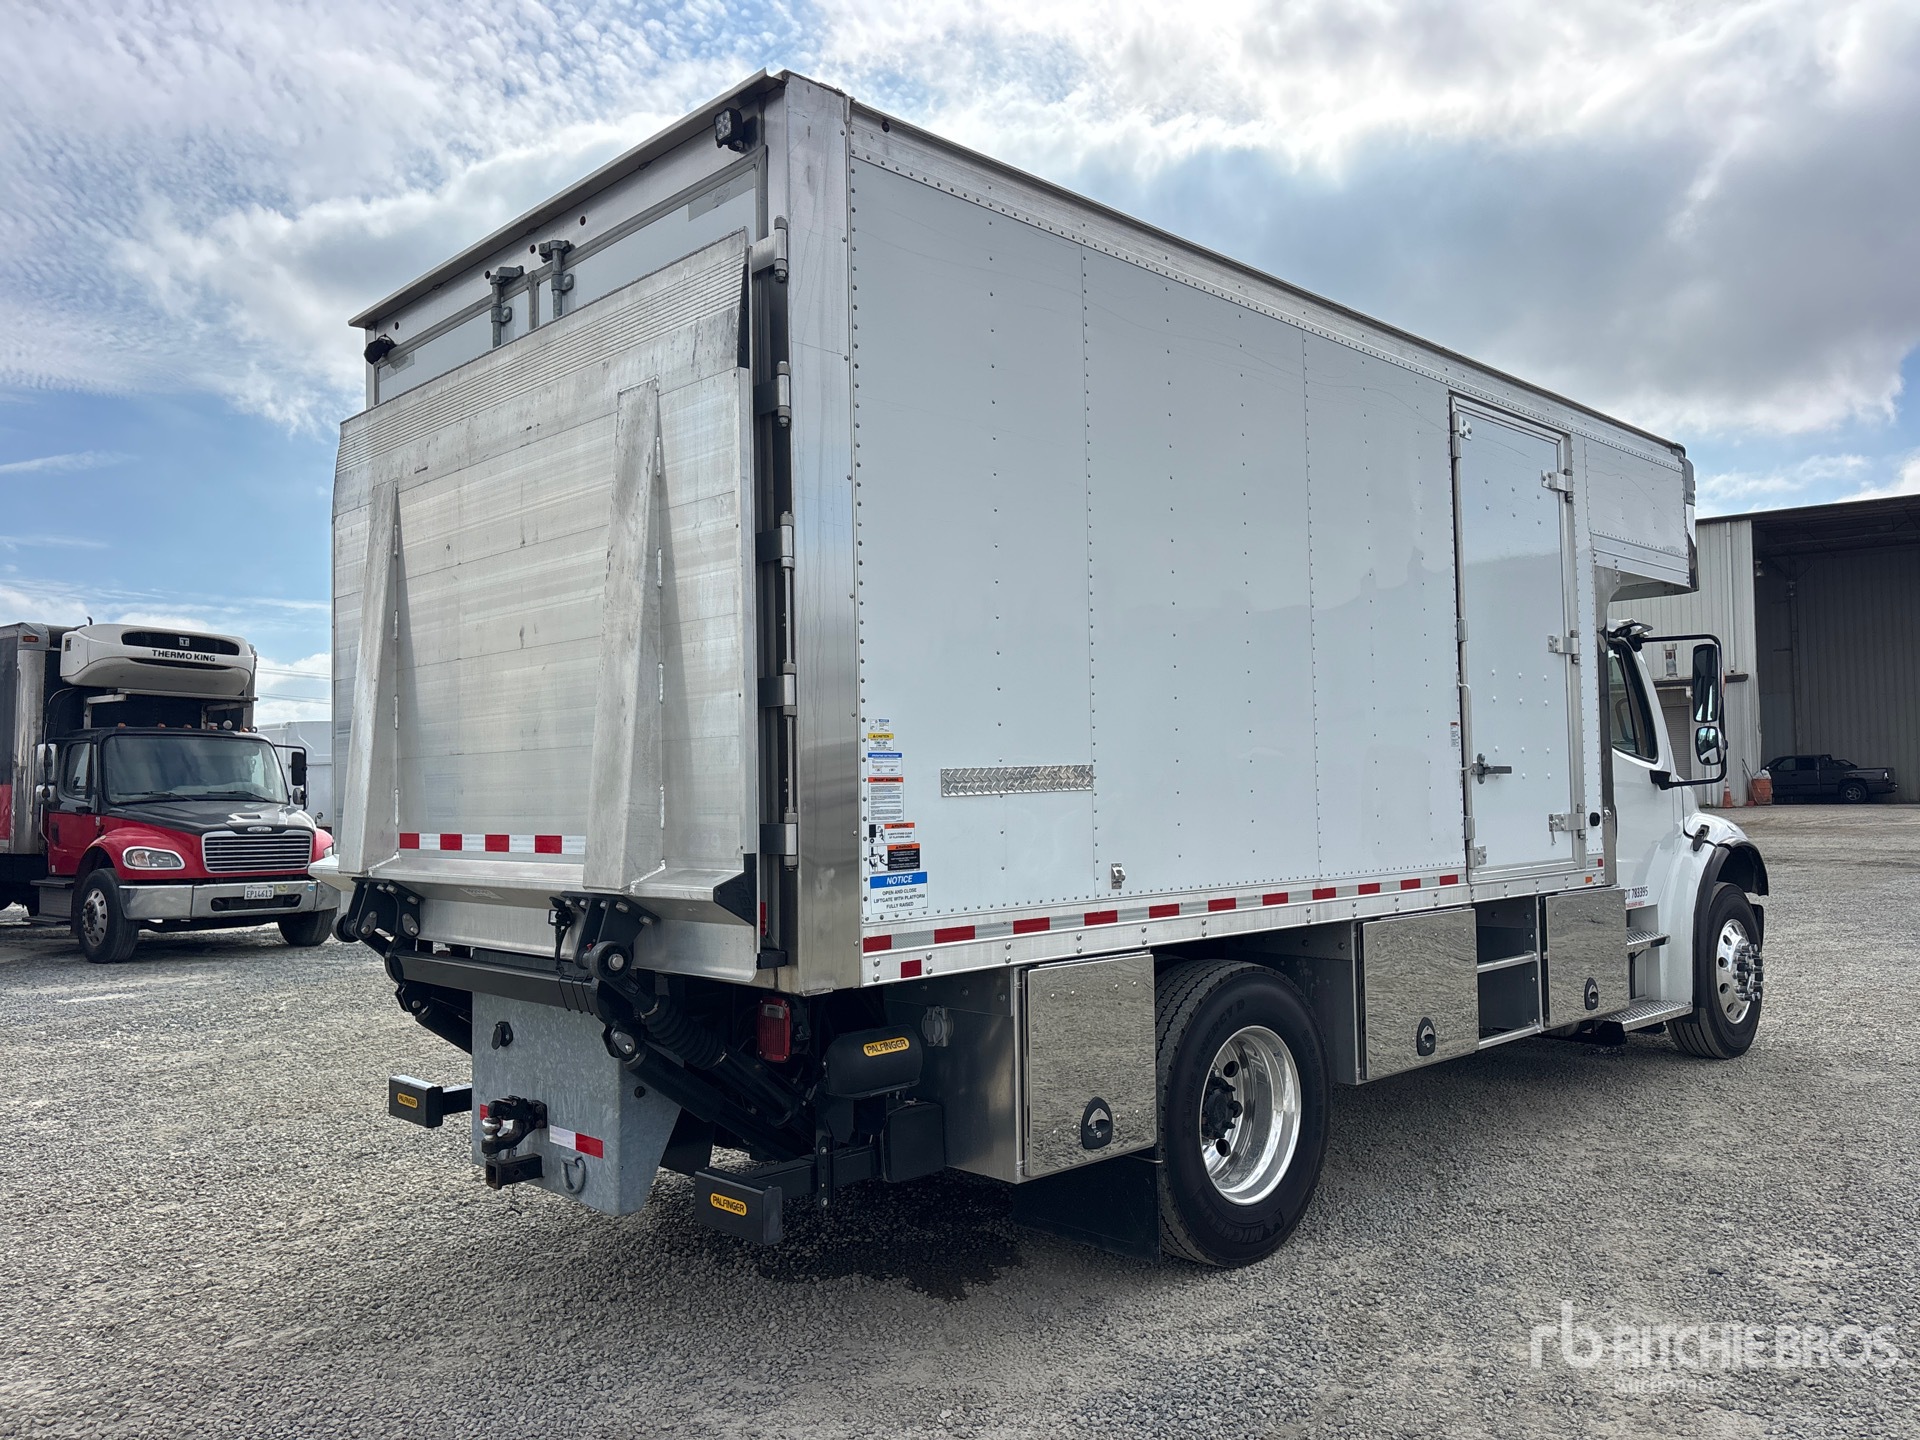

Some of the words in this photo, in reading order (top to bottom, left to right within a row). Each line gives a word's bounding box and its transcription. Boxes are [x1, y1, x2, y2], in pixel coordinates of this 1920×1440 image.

[152, 650, 192, 660] THERMO
[194, 653, 216, 662] KING
[886, 875, 913, 885] NOTICE
[866, 1038, 908, 1054] PALFINGER
[712, 1194, 745, 1213] PALFINGER
